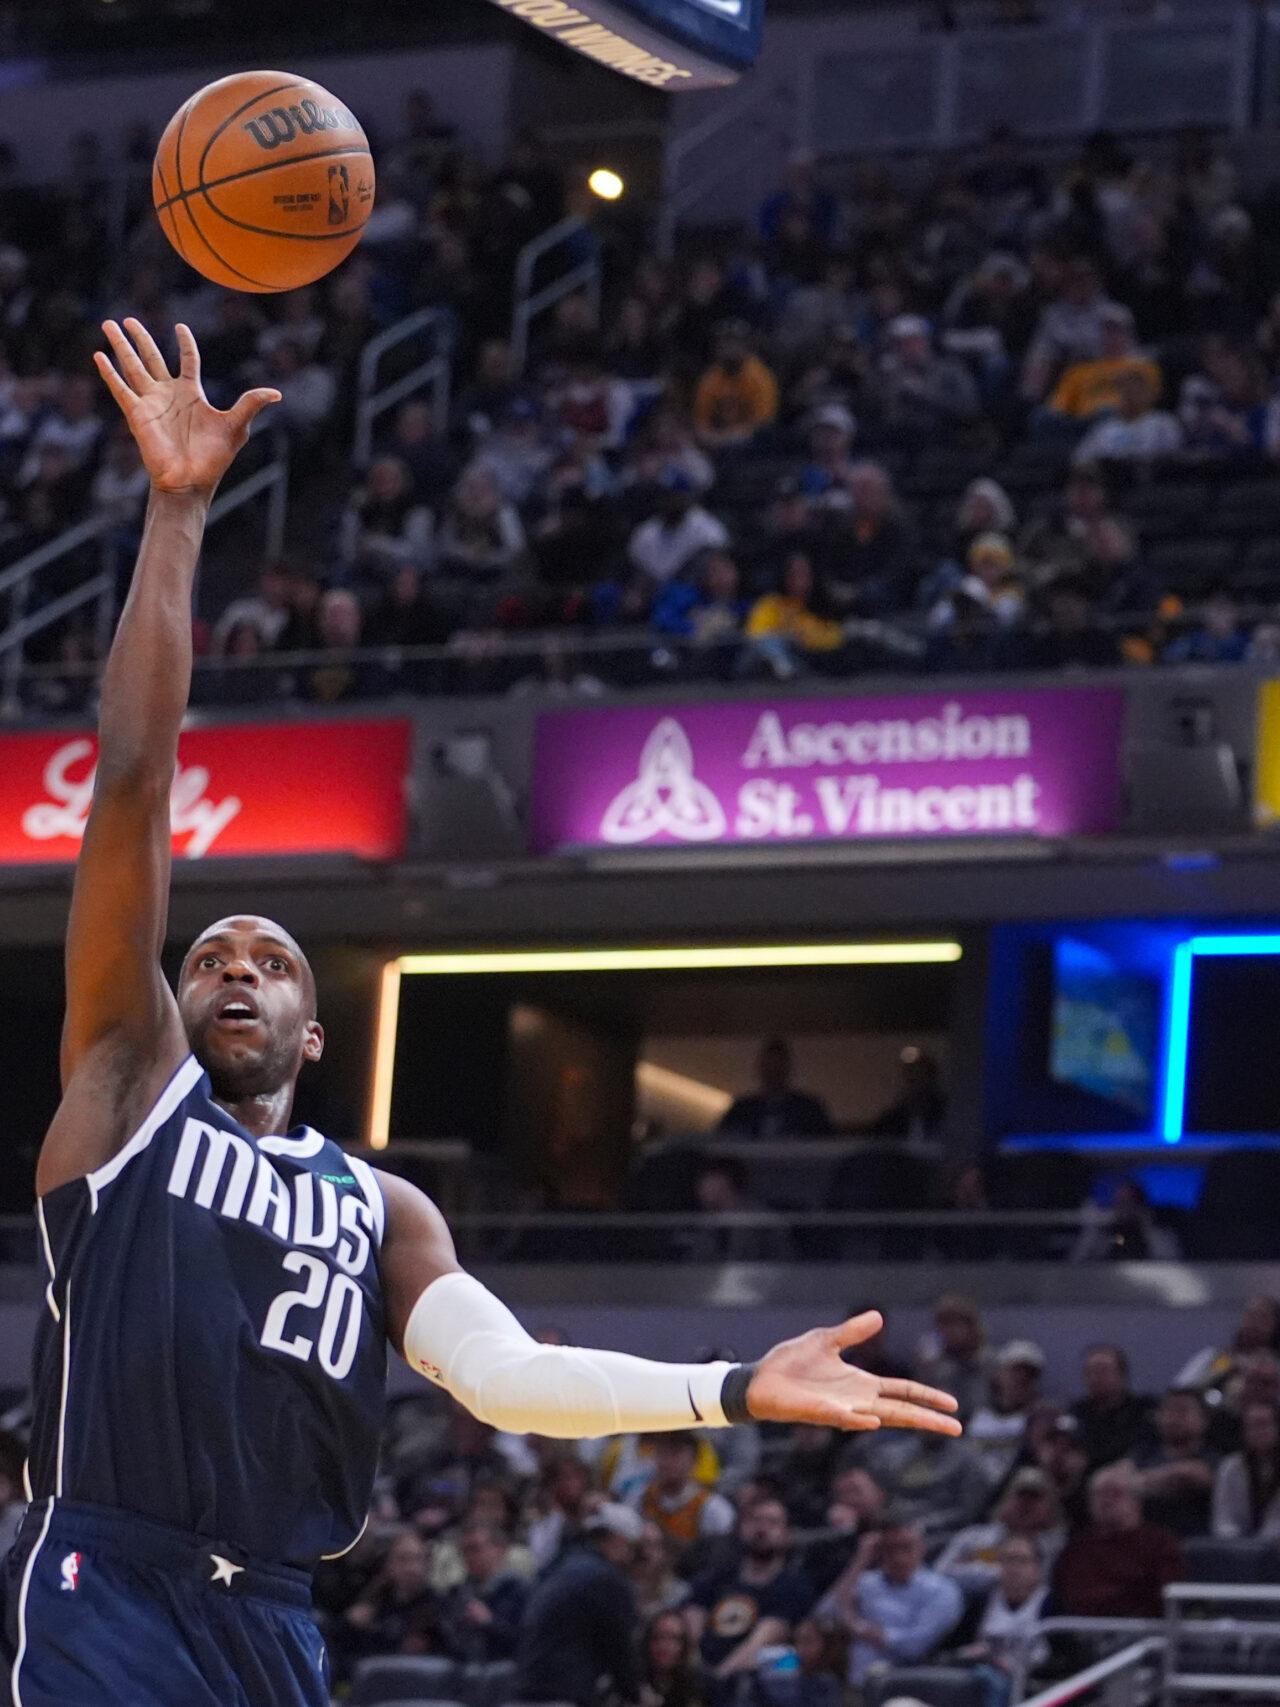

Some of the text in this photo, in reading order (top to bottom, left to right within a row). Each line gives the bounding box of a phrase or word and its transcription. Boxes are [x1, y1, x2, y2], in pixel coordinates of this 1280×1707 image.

[499, 0, 590, 28] OU
[741, 701, 1032, 770] Ascension
[735, 773, 1041, 839] St. Vincent
[260, 1250, 363, 1380] 20
